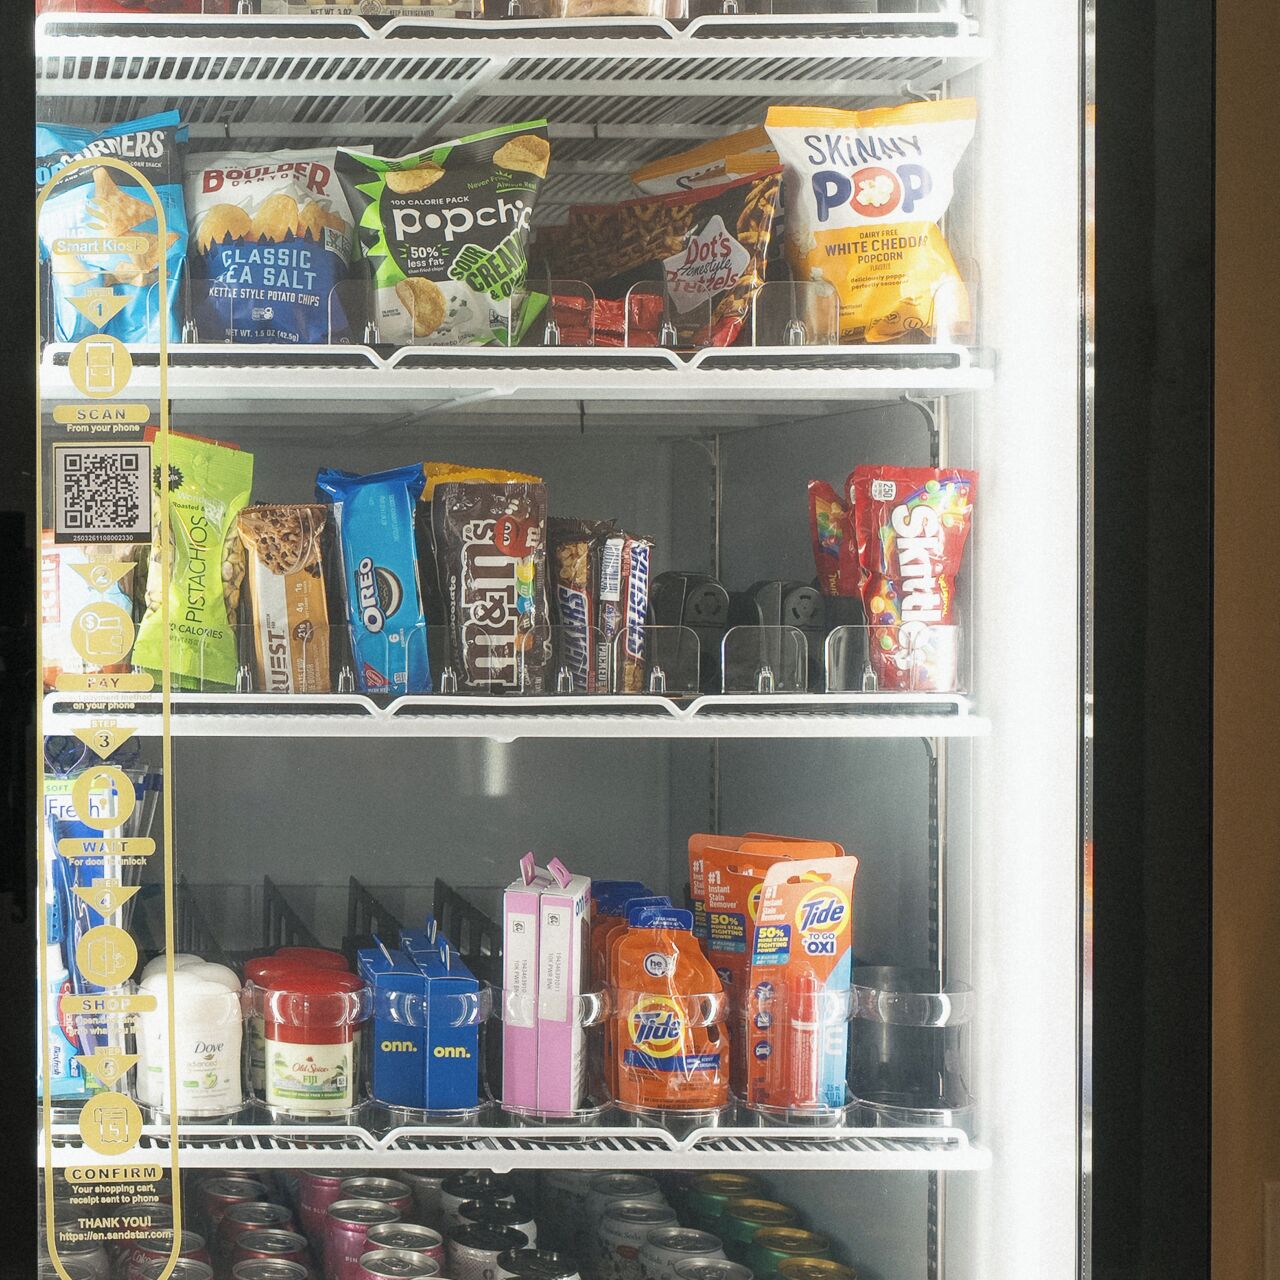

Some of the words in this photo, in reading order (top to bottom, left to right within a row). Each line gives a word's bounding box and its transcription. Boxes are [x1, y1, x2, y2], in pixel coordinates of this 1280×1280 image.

[202, 161, 331, 196] BOULDER
[232, 173, 300, 187] CANYON
[812, 163, 933, 222] POP
[408, 197, 444, 206] CALORIE
[446, 196, 470, 204] PACK
[859, 231, 880, 240] DAIRY
[882, 229, 898, 237] FREE
[58, 240, 99, 253] Smart
[103, 239, 142, 251] Kiosk
[411, 246, 439, 258] 50%
[684, 232, 732, 265] Dot's
[825, 241, 868, 257] WHITE
[871, 235, 928, 251] CHEDDAR
[222, 248, 312, 269] CLASSIC
[408, 259, 427, 268] less
[428, 258, 445, 267] fat
[449, 246, 488, 281] SOUR
[858, 252, 903, 264] POPCORN
[216, 265, 252, 284] EA
[263, 268, 317, 290] SALT
[666, 270, 738, 294] Pretzels
[209, 287, 237, 298] KETTLE
[240, 289, 265, 300] STYLE
[267, 289, 295, 303] POTATO
[298, 293, 320, 307] CHIPS
[489, 288, 500, 300] &
[96, 303, 103, 317] 1
[225, 328, 237, 337] NET
[239, 329, 253, 338] WT.
[255, 329, 265, 337] 1.5
[267, 329, 276, 337] OZ
[277, 329, 299, 343] (42.5g)
[77, 409, 126, 420] SCAN
[67, 424, 90, 432] From
[91, 425, 111, 433] your
[113, 424, 140, 433] phone
[883, 483, 893, 498] 250
[186, 515, 208, 623] PISTACHIOS
[295, 583, 303, 593] 1g
[358, 557, 386, 633] OREO
[296, 603, 304, 613] 4g
[179, 624, 223, 640] CALORIES
[298, 623, 308, 638] 21g
[389, 633, 400, 643] 6
[87, 678, 120, 688] PAY
[86, 703, 106, 711] your
[108, 702, 135, 711] phone
[100, 734, 110, 748] 3
[49, 798, 100, 818] Freh
[82, 842, 128, 853] WAIT
[69, 858, 83, 866] For
[708, 871, 720, 884] #1
[708, 885, 730, 893] Instant
[765, 886, 777, 899] #1
[763, 898, 783, 907] Instant
[711, 914, 738, 925] 50%
[801, 899, 845, 932] Tide
[759, 927, 784, 938] 50%
[807, 941, 835, 954] OXI
[650, 958, 662, 968] he
[634, 1012, 681, 1046] Tide
[195, 1041, 224, 1053] Dove
[381, 1040, 417, 1052] onn.
[434, 1045, 471, 1059] onn.
[292, 1063, 307, 1072] Old
[308, 1063, 329, 1073] Spice
[303, 1075, 318, 1085] FIJI
[72, 1167, 157, 1180] CONFIRM
[72, 1185, 93, 1194] Your
[94, 1184, 135, 1195] shopping
[136, 1184, 156, 1194] cart,
[70, 1195, 99, 1205] receipt
[100, 1195, 119, 1204] sent
[121, 1195, 130, 1204] to
[132, 1194, 160, 1205] phone
[78, 1218, 119, 1229] THANK
[121, 1217, 152, 1228] YOU!
[59, 1230, 172, 1242] https://en.sandstar.com
